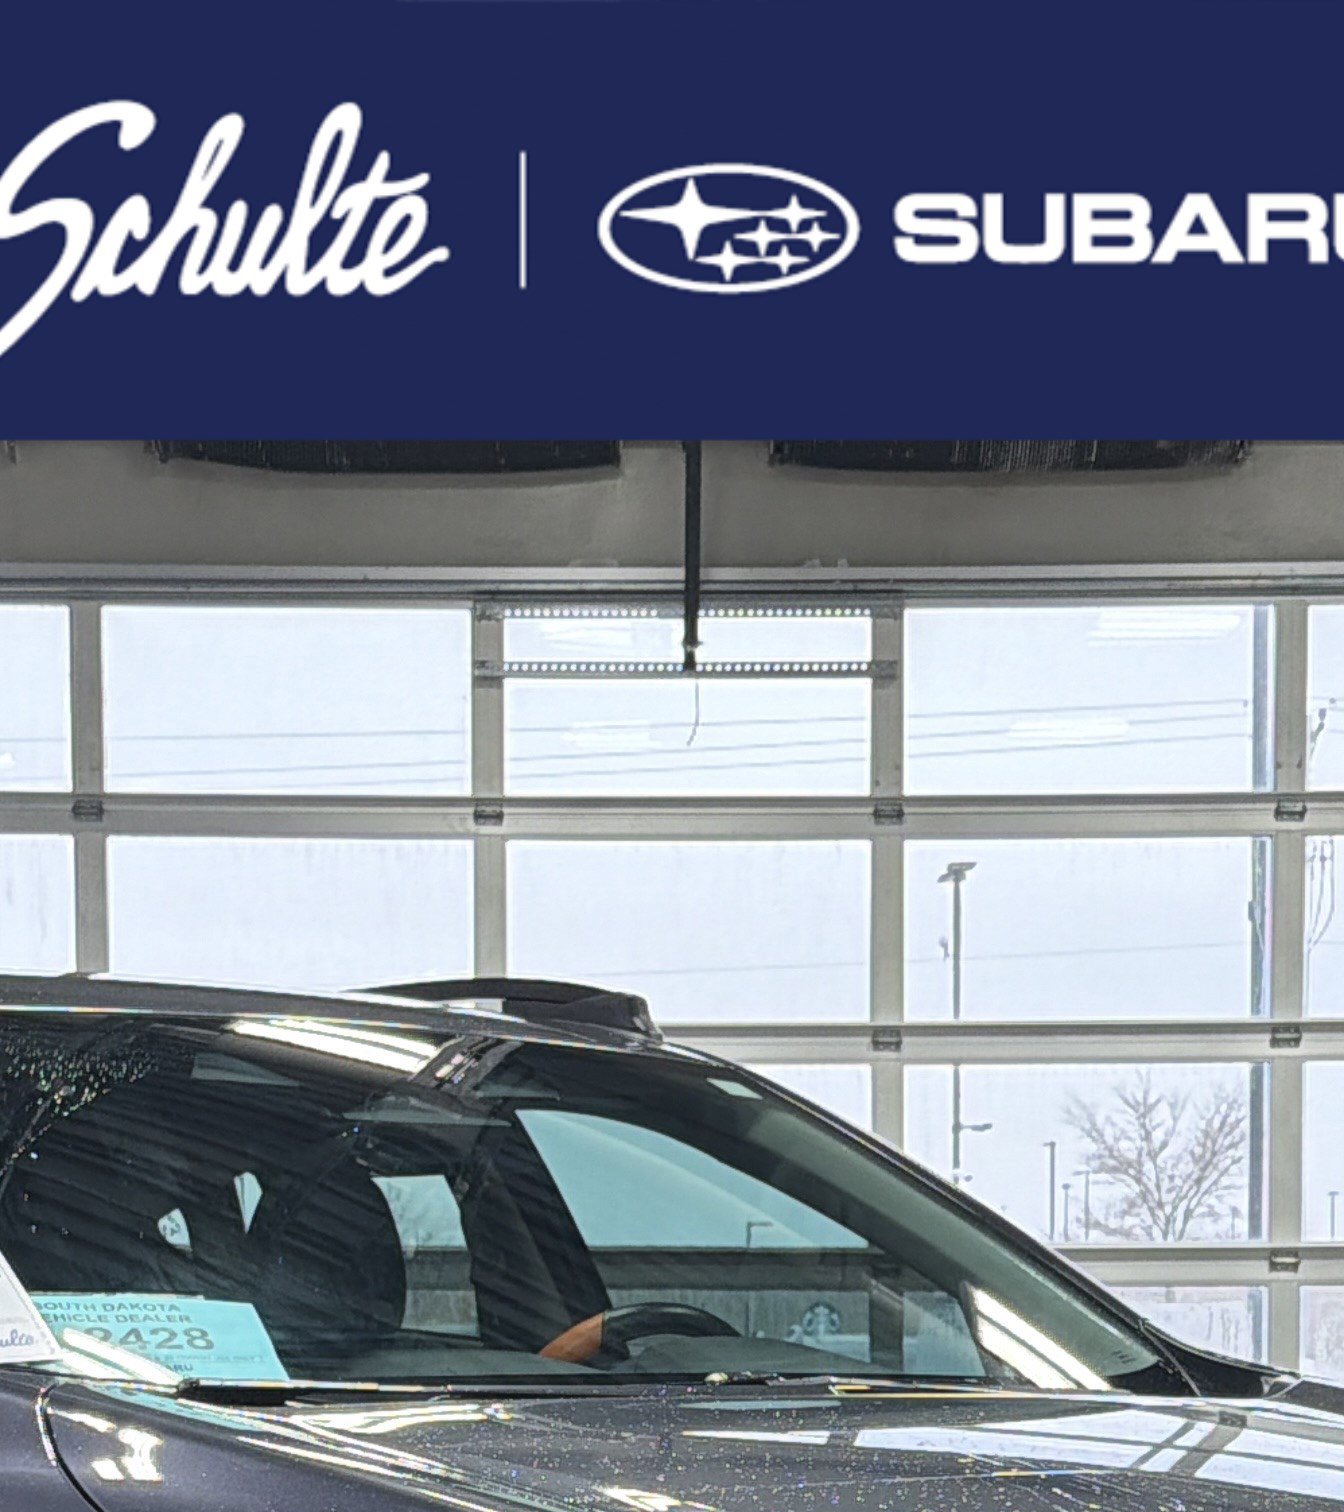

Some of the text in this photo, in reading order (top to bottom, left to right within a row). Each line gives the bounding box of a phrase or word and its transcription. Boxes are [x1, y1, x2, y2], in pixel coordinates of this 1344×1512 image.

[102, 1301, 182, 1312] DAKOTA
[41, 1313, 195, 1324] EHICLE DEALER
